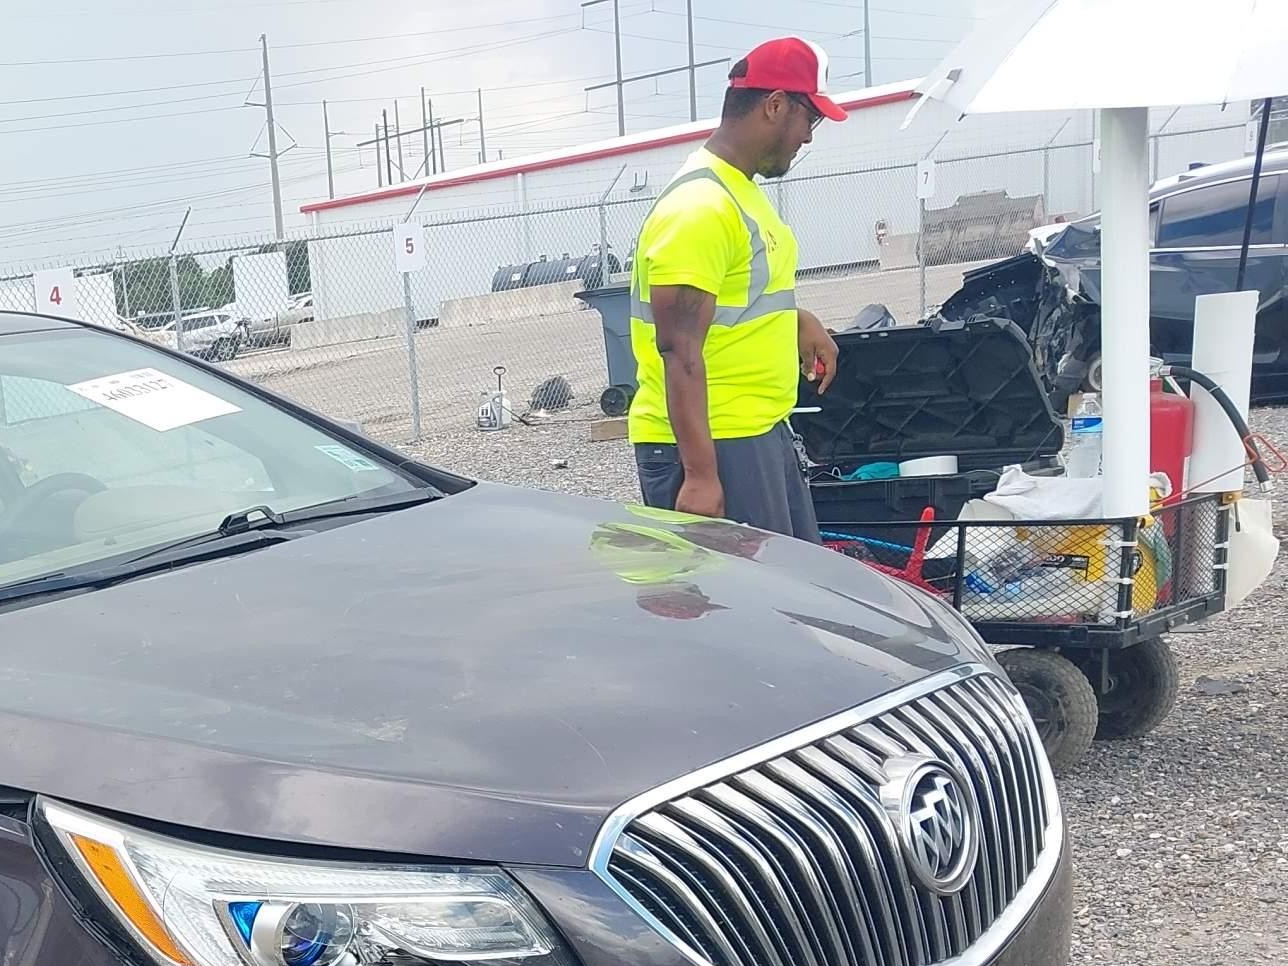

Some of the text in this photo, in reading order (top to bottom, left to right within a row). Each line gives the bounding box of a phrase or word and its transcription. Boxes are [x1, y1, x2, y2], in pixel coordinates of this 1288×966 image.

[923, 171, 929, 185] 7
[405, 237, 414, 254] 5
[50, 286, 62, 305] 4
